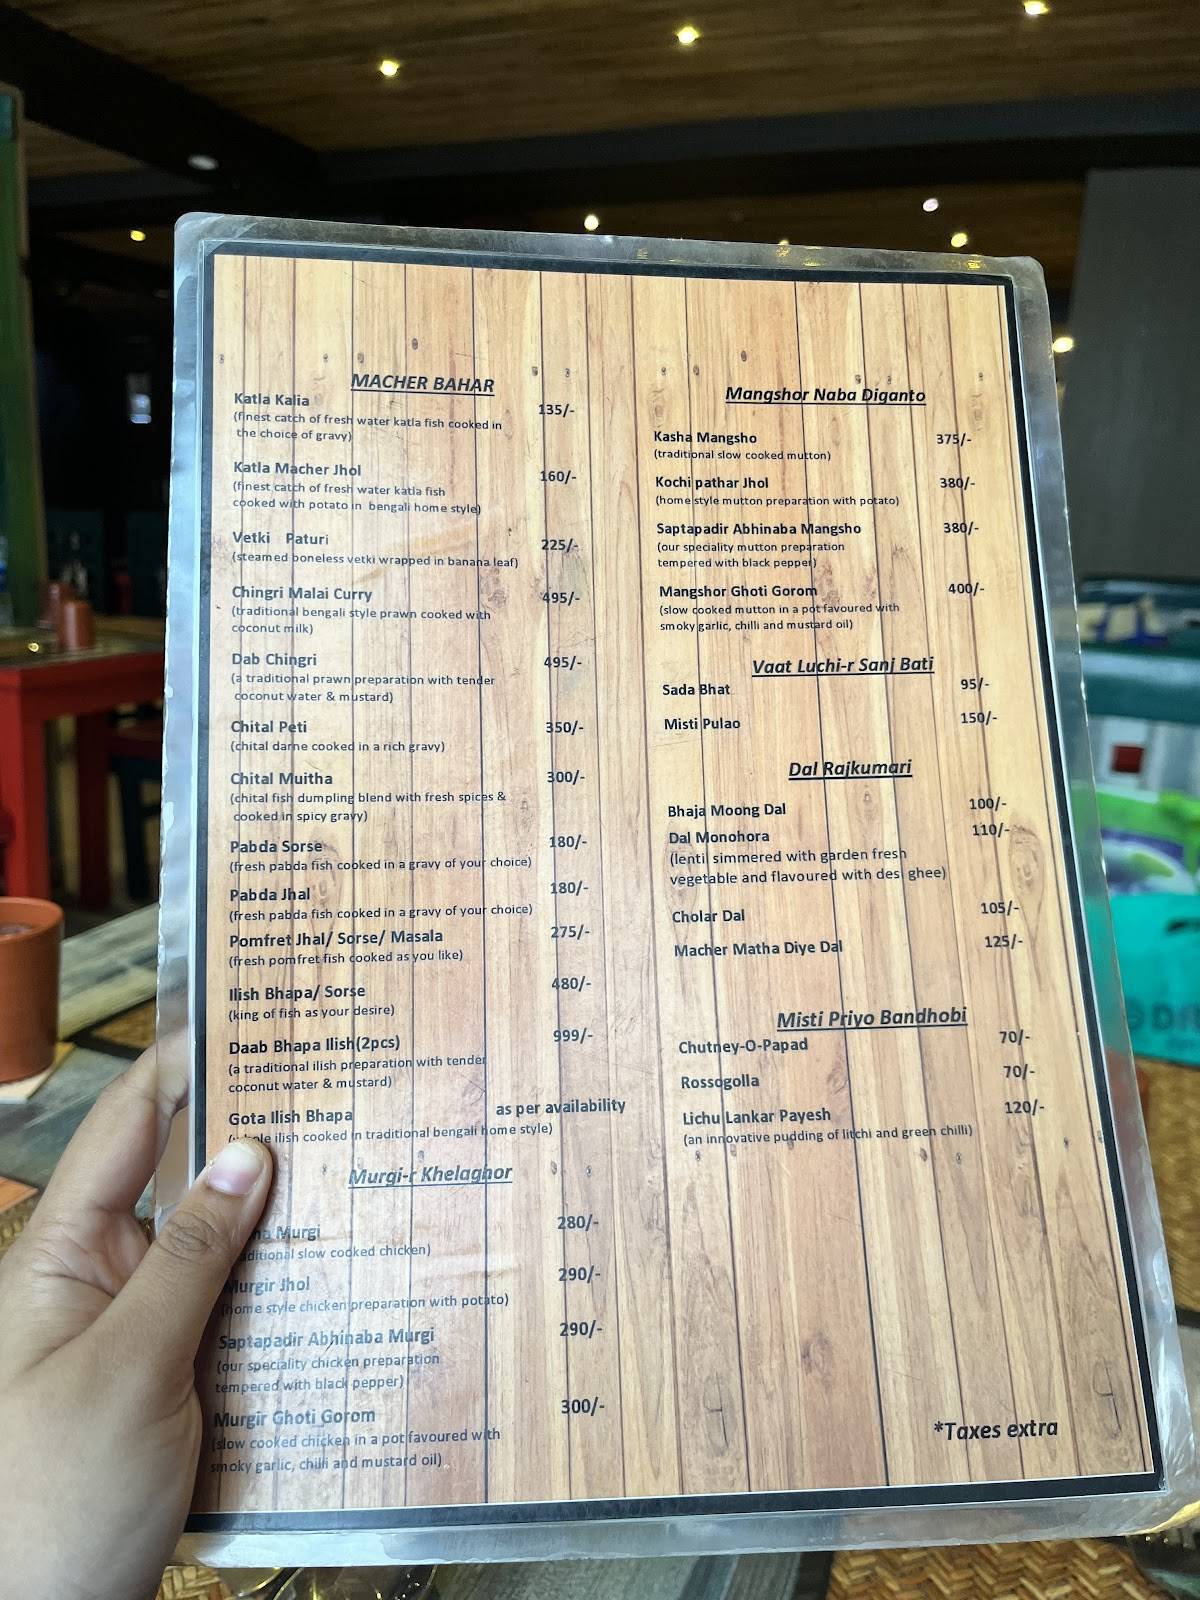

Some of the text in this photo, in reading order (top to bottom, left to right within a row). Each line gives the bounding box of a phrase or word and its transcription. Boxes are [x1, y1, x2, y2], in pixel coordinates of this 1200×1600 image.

[351, 373, 495, 392] MACHER BAHAR
[234, 393, 310, 406] Katla Kalia
[726, 387, 926, 404] Mangshor Naba Diganto
[539, 404, 575, 417] 135/-
[234, 412, 271, 422] (finest
[275, 414, 305, 423] catch
[310, 414, 320, 423] of
[324, 415, 353, 424] fresh
[394, 418, 421, 427] katla
[425, 419, 444, 428] fish
[449, 420, 488, 429] cooked
[492, 421, 502, 430] in
[654, 431, 757, 445] Kasha Mangsho
[937, 433, 972, 447] 375/-
[654, 450, 831, 460] (traditional slow cooked mutton)
[234, 462, 361, 476] Katla Macher Jhol
[540, 470, 577, 484] 160/-
[656, 477, 769, 490] Kochi pathar Jhol
[940, 477, 975, 490] 380/-
[657, 523, 861, 536] Saptapadir Abhinaba Mangsho
[944, 522, 979, 535] 380/-
[233, 532, 328, 544] Vetki Paturi
[541, 539, 578, 552] 225/-
[658, 542, 845, 553] (our speciality mutton preparation
[232, 586, 372, 602] Chingri Malai Curry
[659, 586, 817, 599] Mangshor Ghoti Gorom
[949, 582, 984, 596] 400/-
[542, 592, 580, 606] 495/-
[232, 653, 317, 667] Dab Chingri
[544, 656, 582, 670] 495/-
[753, 657, 934, 673] Vaat Luchi-r Sanj Bati
[663, 684, 730, 695] Sada Bhat
[961, 678, 990, 692] 95/-
[664, 718, 740, 729] Misti Pulao
[961, 711, 997, 725] 150/-
[231, 721, 307, 732] Chital Peti
[546, 720, 583, 735] 350/-
[789, 760, 912, 777] Dal Rajkumari
[231, 772, 332, 784] Chital Muitha
[547, 770, 585, 785] 300/-
[668, 803, 786, 819] Bhaja Moong Dal
[969, 797, 1007, 811] 100/-
[669, 831, 769, 844] Dal Monohora
[973, 823, 1010, 837] 110/-
[230, 840, 322, 852] Pabda Sorse
[550, 835, 587, 850] 180/-
[230, 888, 310, 901] Pabda Jhal
[550, 881, 588, 896] 180/-
[981, 901, 1019, 915] 105/-
[672, 910, 745, 922] Cholar Dal
[230, 930, 443, 947] Pomfret Jhal/ Sorse/ Masala
[550, 924, 590, 940] 275/-
[675, 940, 842, 957] Macher Matha Diye Dal
[985, 934, 1023, 949] 125/-
[552, 976, 591, 992] 480/-
[229, 985, 365, 1001] Ilish Bhapa/ Sorse
[229, 1004, 394, 1022] (king of fish as your desire)
[777, 1007, 967, 1028] Misti Priyo Bandhobi
[553, 1028, 592, 1044] 999/-
[1000, 1029, 1030, 1045] 70/-
[229, 1035, 400, 1054] Daab Bhapa Ilish(2pcs)
[679, 1038, 808, 1055] Chutney-O-Papad
[1003, 1064, 1035, 1080] 70/-
[682, 1074, 760, 1090] Rossogolla
[496, 1099, 625, 1117] as per availability
[1005, 1099, 1044, 1115] 120/-
[229, 1109, 353, 1125] Gota Ilish Bhapa
[683, 1108, 831, 1125] Lichu Lankar Payesh
[684, 1125, 972, 1146] (an innovative pudding of litchi and green chilli)
[349, 1165, 512, 1186] Murgi-r Khelaghor
[557, 1214, 599, 1232] 280/-
[276, 1225, 320, 1241] Murgi
[559, 1265, 600, 1283] 290/-
[280, 1277, 310, 1291] Jhol
[560, 1320, 602, 1338] 290/-
[219, 1327, 434, 1351] Saptapadir Abhinaba Murgi
[561, 1397, 605, 1416] 300/-
[273, 1410, 315, 1425] Ghoti
[321, 1409, 375, 1424] Gorom
[1007, 1420, 1057, 1437] extra
